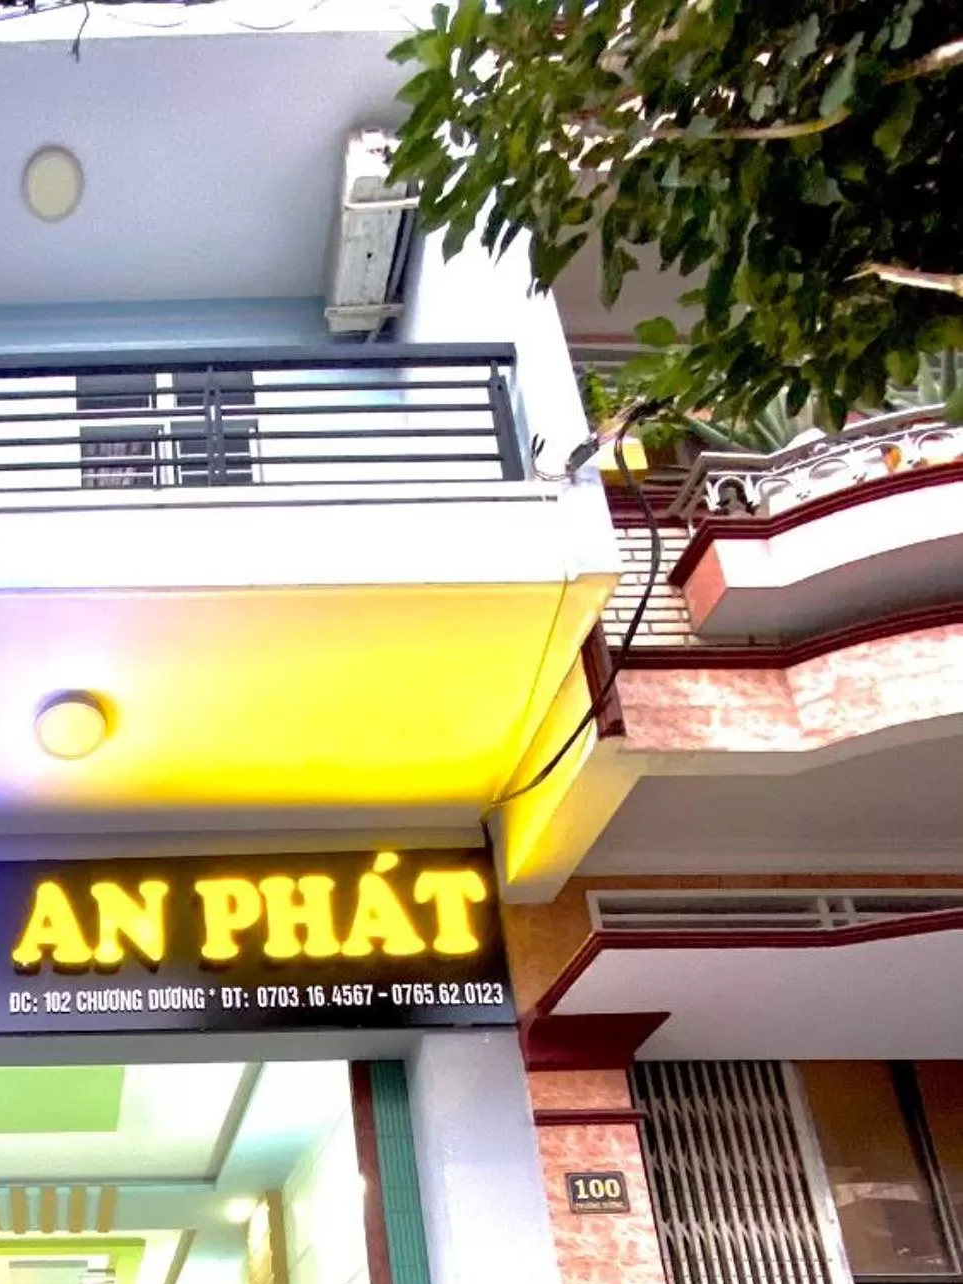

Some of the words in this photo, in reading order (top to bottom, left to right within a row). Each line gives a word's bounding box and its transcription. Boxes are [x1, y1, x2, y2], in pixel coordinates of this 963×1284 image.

[11, 880, 169, 966] AN
[196, 851, 488, 962] PHÁT
[43, 990, 72, 1013] 102
[75, 987, 142, 1012] CHƯƠNG
[147, 985, 206, 1010] DƯƠNG
[221, 987, 249, 1008] ĐT:
[257, 984, 374, 1008] 0703.16.4567
[392, 983, 504, 1006] 0765.62.0123
[574, 1179, 621, 1199] 100
